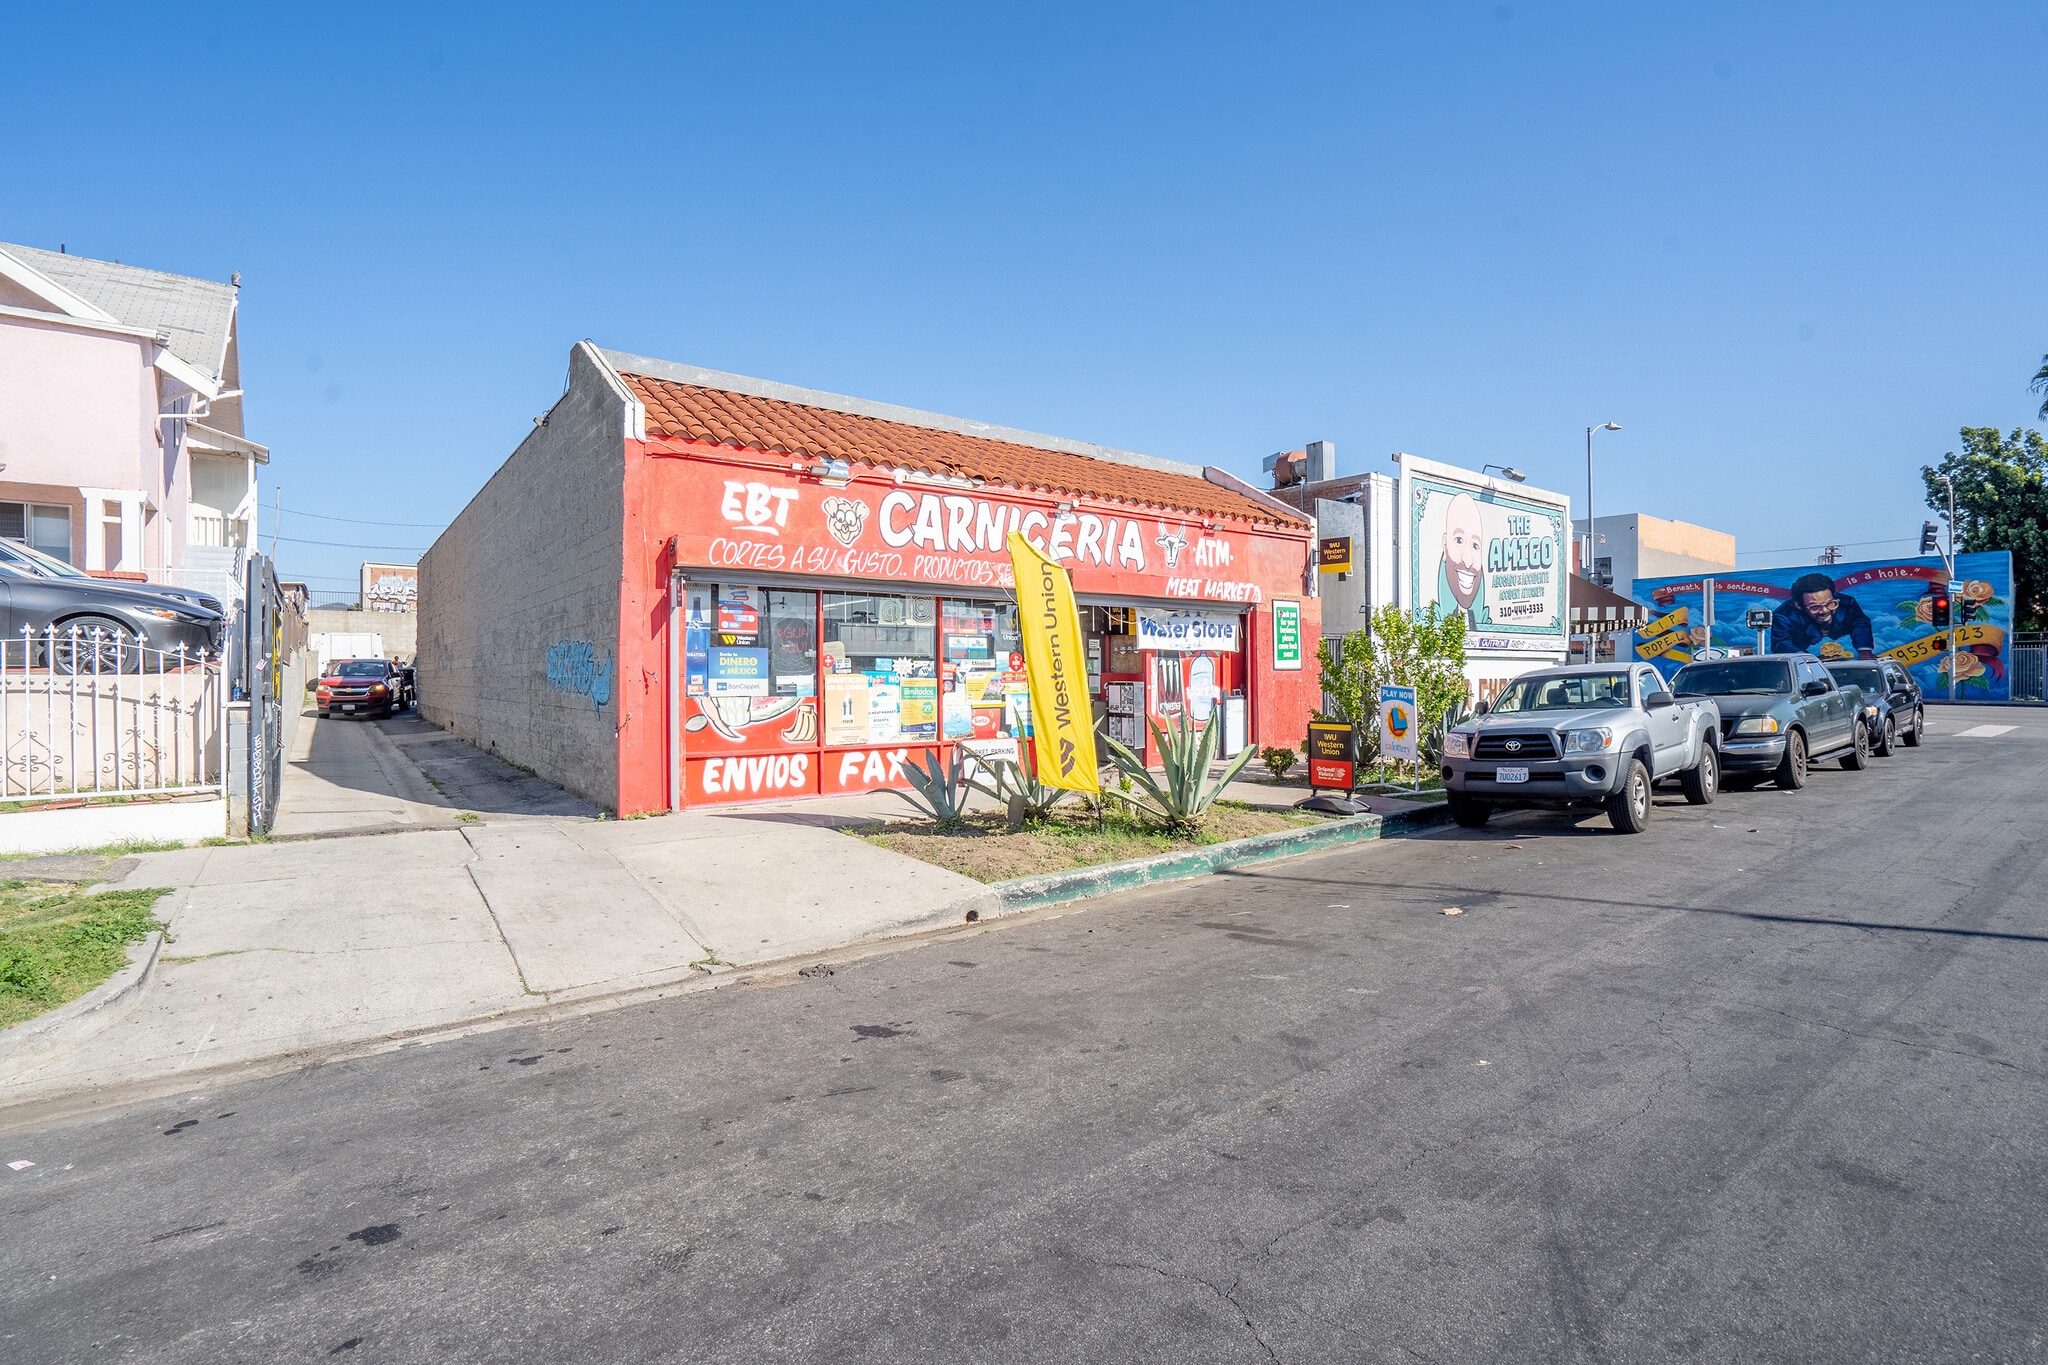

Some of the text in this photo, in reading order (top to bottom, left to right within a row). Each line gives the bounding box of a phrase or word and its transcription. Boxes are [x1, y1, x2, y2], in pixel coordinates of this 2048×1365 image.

[721, 481, 799, 527] EBT
[1508, 515, 1531, 535] THE
[709, 538, 786, 569] CORTES
[790, 547, 803, 568] A
[807, 547, 836, 571] SU
[914, 554, 994, 584] PRODUCTOS
[1488, 536, 1553, 573] AMIGO
[1492, 574, 1516, 588] ABOGADO
[1522, 571, 1549, 585] ACCIDENTE
[1847, 576, 1857, 585] is
[1864, 572, 1871, 580] a
[1165, 577, 1254, 601] MEAT MARKET
[1499, 586, 1544, 601] ACCIDENT ATTORNEYS
[1726, 582, 1770, 594] sentence
[777, 627, 808, 639] AGUA
[1140, 617, 1233, 638] Water Store
[1041, 561, 1071, 730] Western Union
[720, 658, 758, 666] DINERO
[1382, 690, 1413, 700] PLAY NOW
[1317, 741, 1344, 749] Western
[1321, 748, 1340, 756] Union
[702, 753, 808, 794] ENVIOS
[838, 748, 908, 787] FAX
